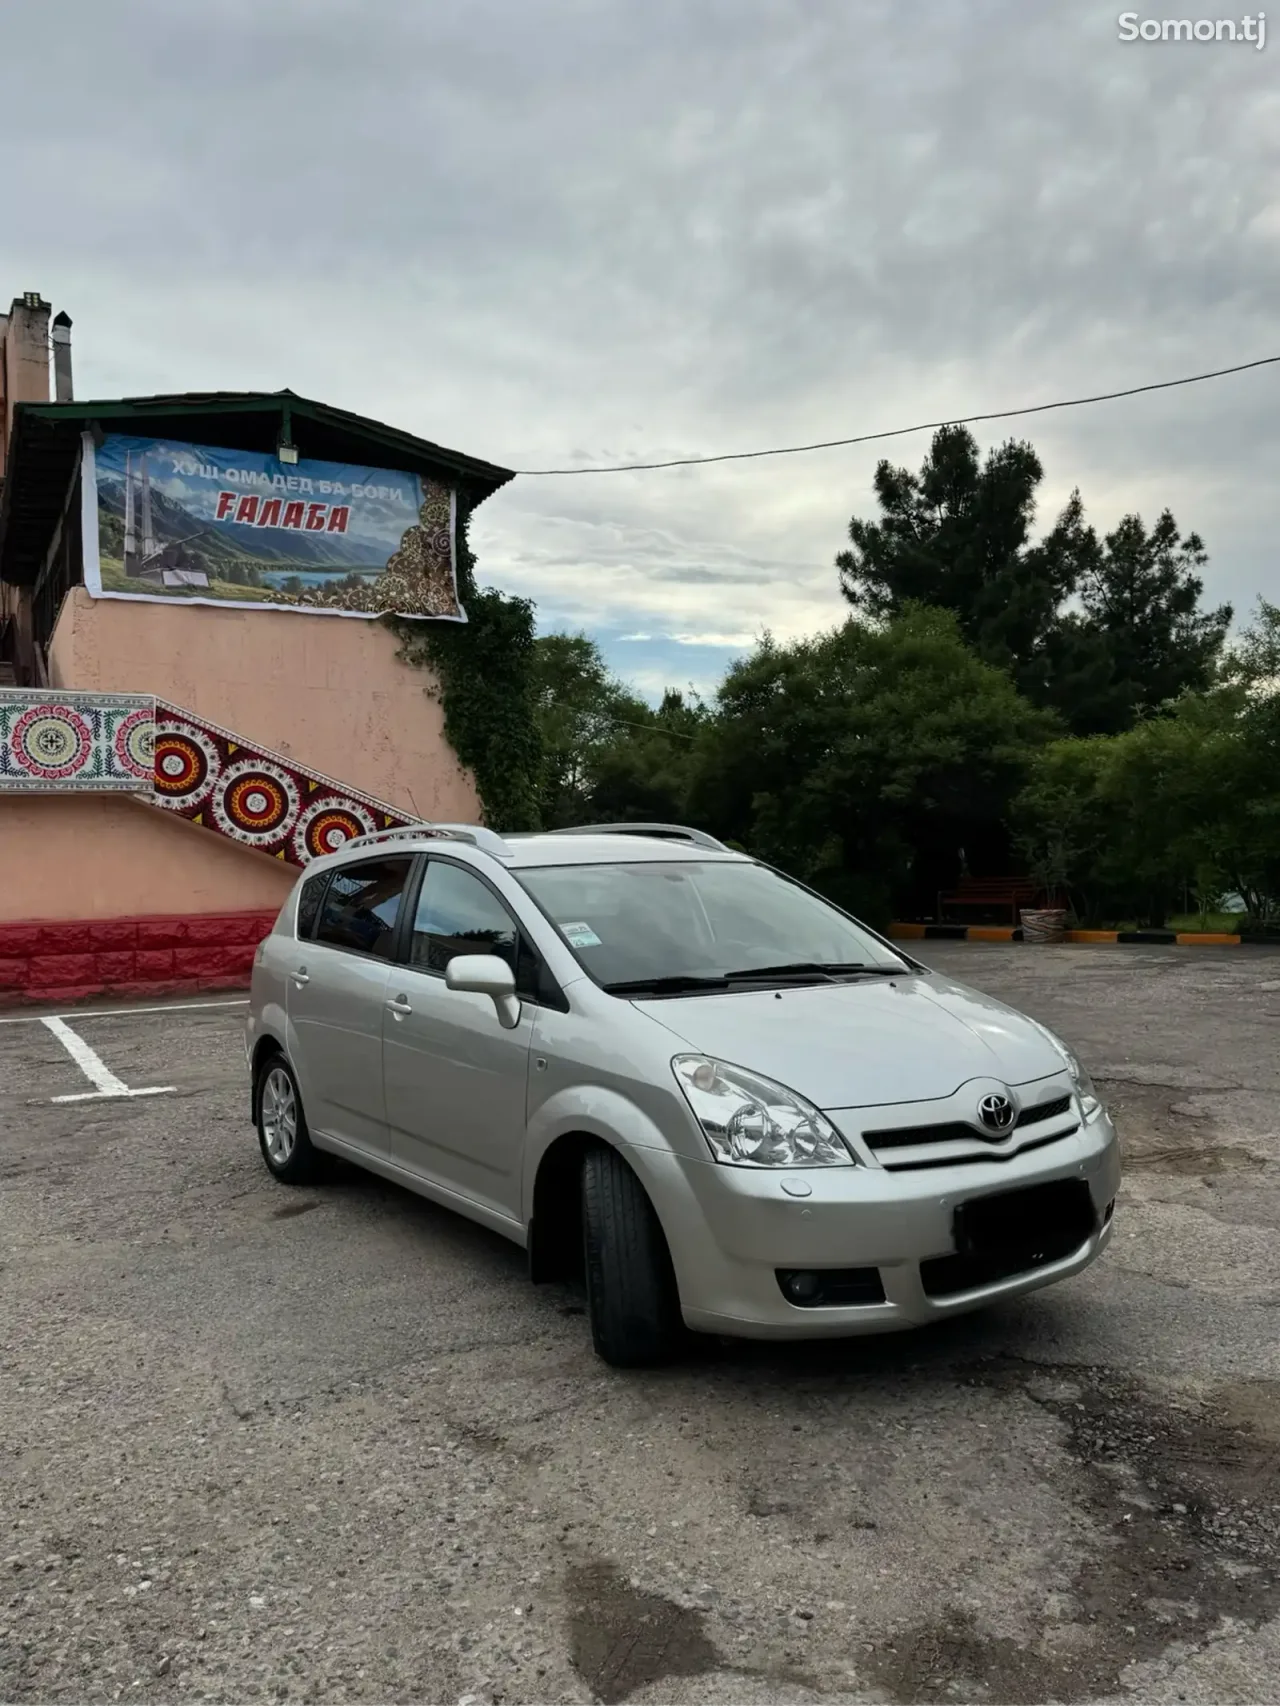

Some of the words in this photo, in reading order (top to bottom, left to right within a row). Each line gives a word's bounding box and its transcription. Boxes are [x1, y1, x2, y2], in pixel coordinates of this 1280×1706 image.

[172, 459, 219, 480] ХУШ
[224, 468, 314, 496] ОМАДЕД
[319, 479, 347, 496] БА
